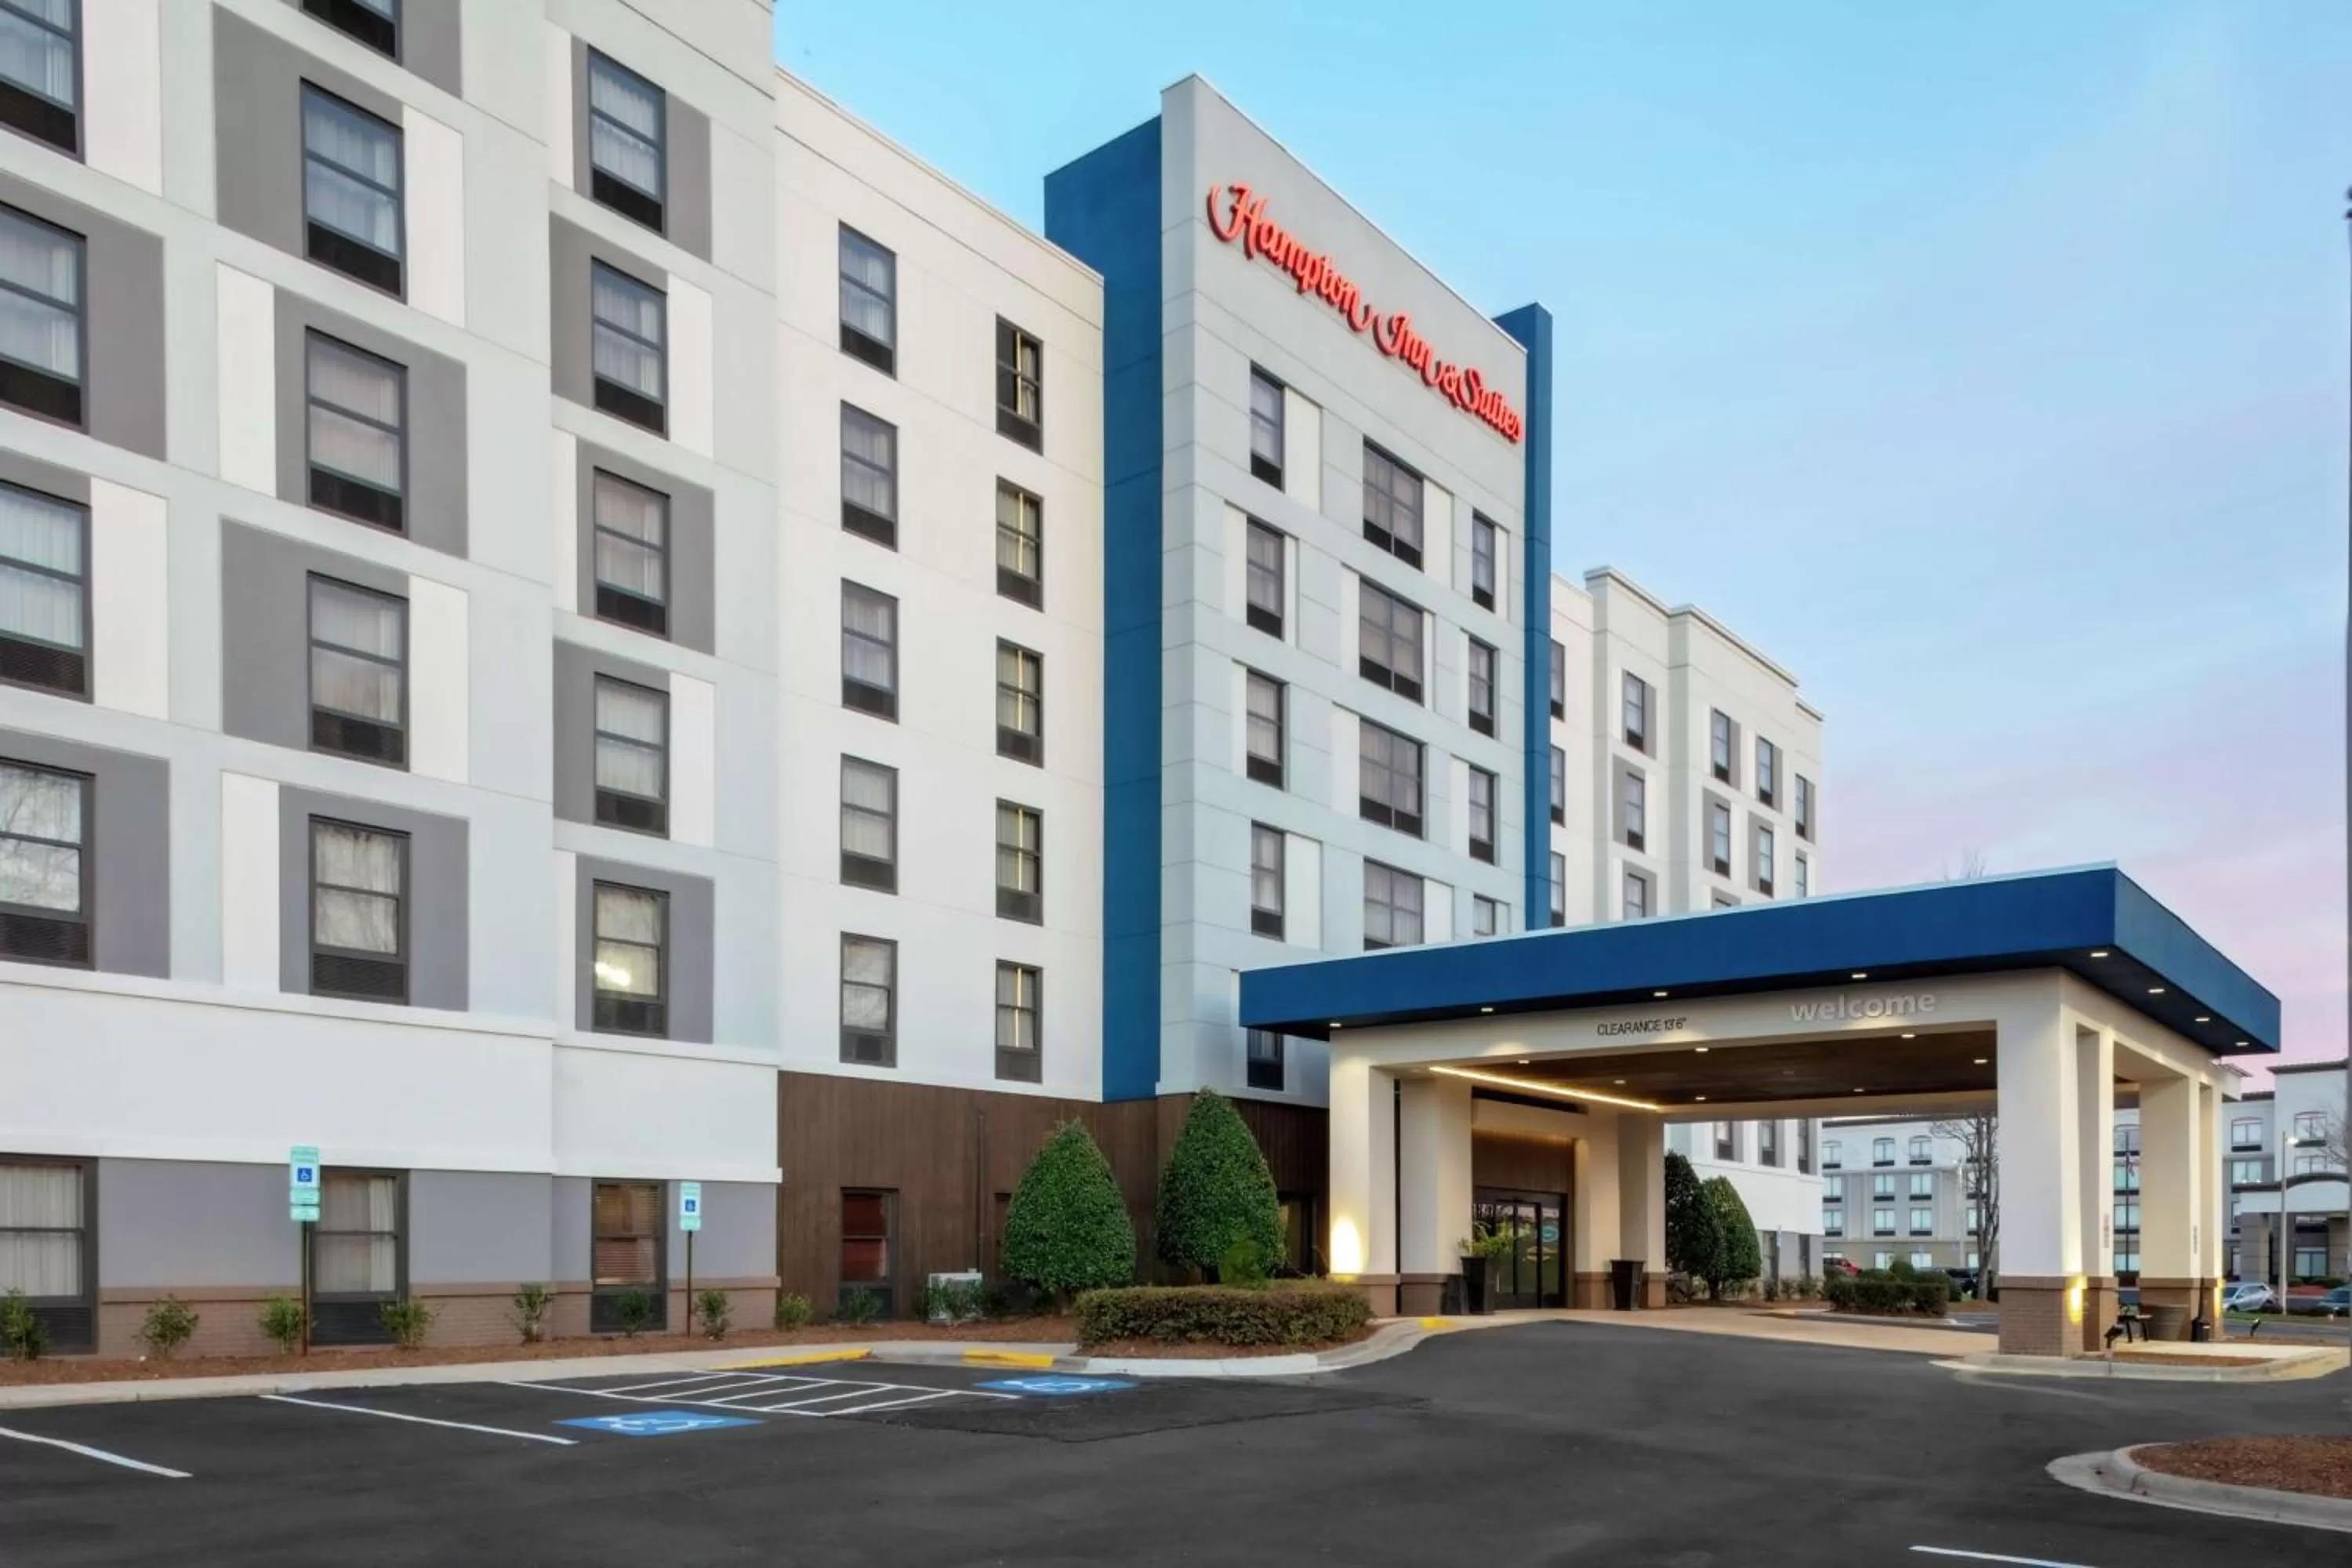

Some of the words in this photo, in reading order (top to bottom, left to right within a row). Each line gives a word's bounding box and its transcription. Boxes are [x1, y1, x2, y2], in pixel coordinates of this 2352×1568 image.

[1207, 183, 1370, 333] Hampton
[1373, 313, 1443, 387] Inn
[1455, 366, 1523, 445] Suites
[1790, 993, 1936, 1022] welcome
[1597, 1019, 1662, 1036] CLEARANCE
